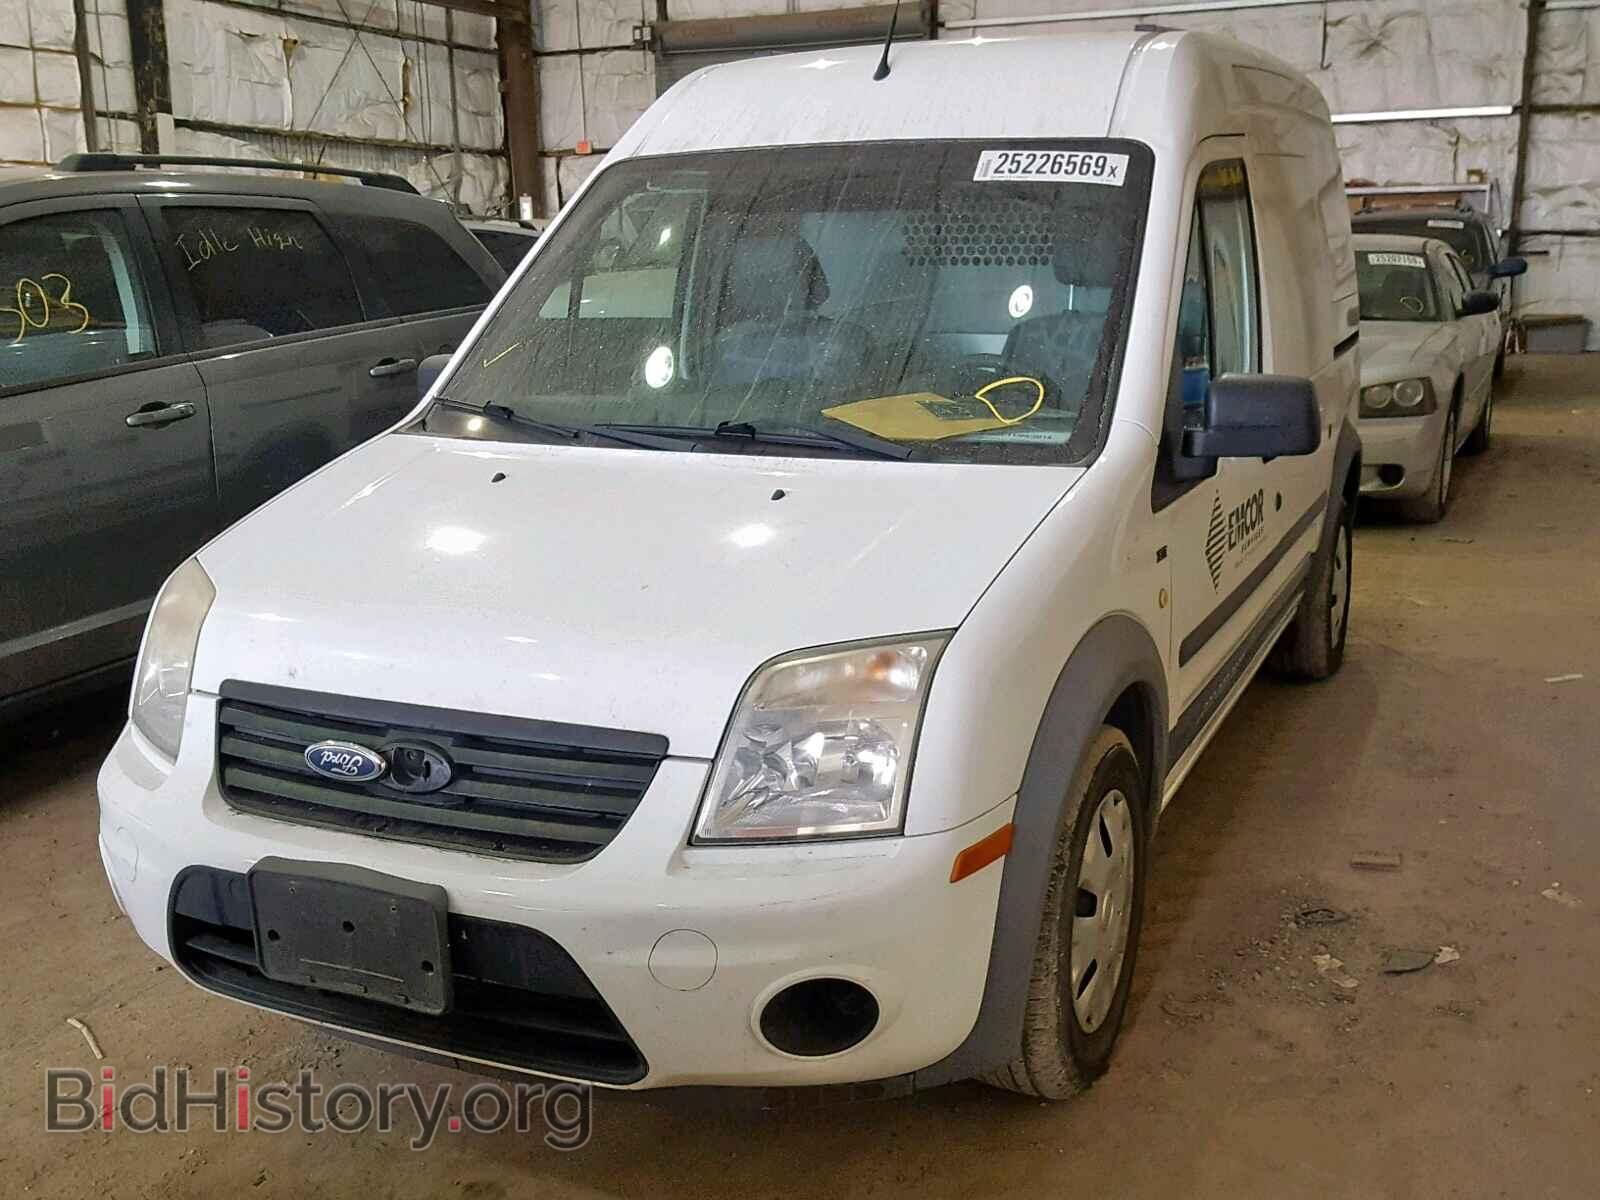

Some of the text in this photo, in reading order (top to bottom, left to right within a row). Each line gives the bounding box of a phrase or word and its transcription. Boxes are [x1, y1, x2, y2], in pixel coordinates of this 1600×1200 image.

[994, 152, 1108, 177] 25226569
[1228, 488, 1264, 552] EMCOR
[319, 749, 364, 777] Ford
